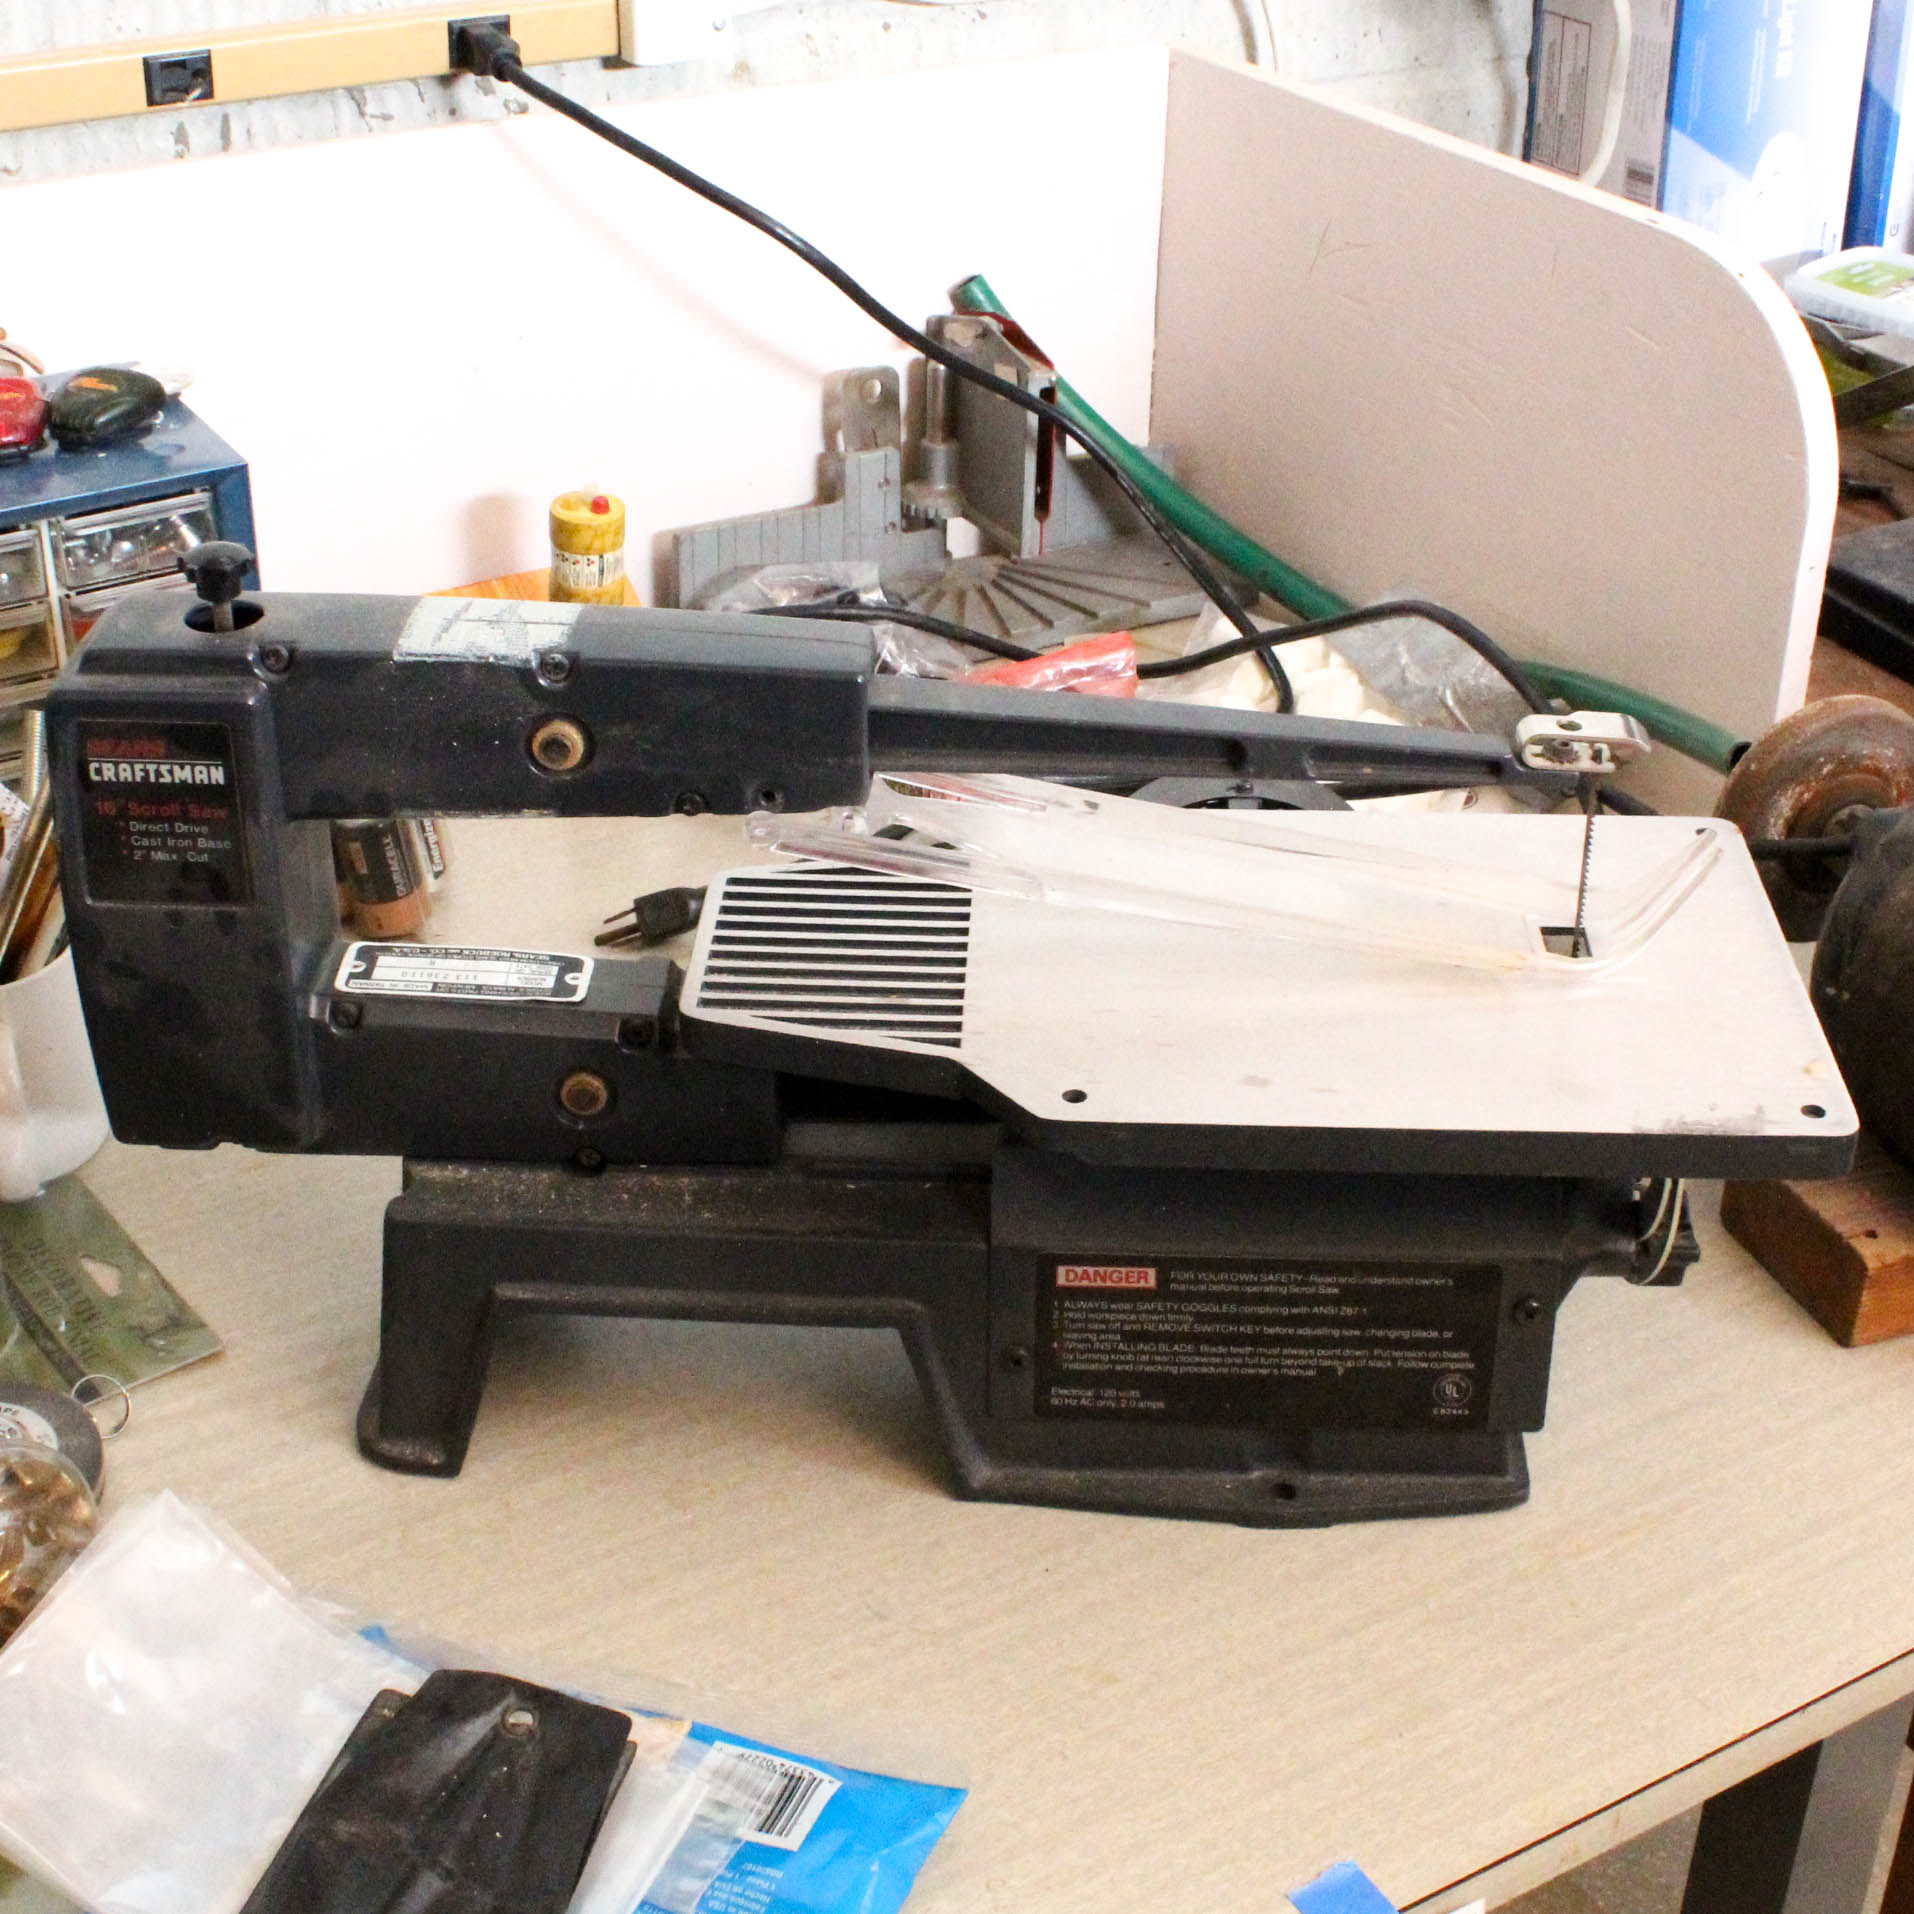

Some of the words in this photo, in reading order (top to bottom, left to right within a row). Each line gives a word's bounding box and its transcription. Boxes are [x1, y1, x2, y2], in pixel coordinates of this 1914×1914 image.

[89, 761, 225, 785] CRAFTSMAN
[129, 821, 169, 833] Direct
[174, 822, 209, 834] Drive
[131, 836, 162, 847] Cast
[168, 837, 193, 848] Iron
[198, 838, 232, 850] Base
[187, 852, 209, 863] Cut
[383, 833, 407, 896] DURACELL
[1064, 1268, 1150, 1284] DANGER
[1170, 1272, 1194, 1282] FOR
[1196, 1272, 1229, 1282] YOUR
[1231, 1273, 1259, 1283] OWN
[1260, 1274, 1302, 1284] SAFETY
[1170, 1282, 1206, 1292] manual
[1208, 1283, 1240, 1293] before
[1242, 1284, 1288, 1296] operating
[1289, 1285, 1318, 1295] Scroll
[1064, 1300, 1109, 1310] ALWAYS
[1110, 1303, 1134, 1311] wear
[1136, 1302, 1180, 1312] SAFETY
[1181, 1303, 1237, 1313] GOGGLES
[1239, 1304, 1289, 1316] complying
[1291, 1305, 1310, 1315] with
[1312, 1305, 1338, 1316] ANSI
[1064, 1312, 1086, 1321] Hold
[1086, 1312, 1138, 1324] workpiece
[1139, 1313, 1164, 1322] down
[1065, 1321, 1086, 1330] Turn
[1109, 1321, 1122, 1331] off
[1123, 1322, 1143, 1331] and
[1144, 1322, 1191, 1332] REMOVE
[1194, 1323, 1238, 1333] SWITCH
[1239, 1324, 1261, 1334] KEY
[1263, 1325, 1295, 1335] before
[1296, 1326, 1340, 1338] adjusting
[1365, 1327, 1410, 1339] changing
[1065, 1342, 1092, 1351] When
[1093, 1343, 1156, 1352] INSTALLING
[1200, 1345, 1228, 1354] Blade
[1230, 1345, 1255, 1355] teeth
[1257, 1346, 1280, 1355] must
[1281, 1347, 1315, 1358] always
[1316, 1347, 1341, 1358] point
[1391, 1349, 1426, 1358] tension
[1063, 1352, 1075, 1363] by
[1076, 1352, 1109, 1364] turning
[1110, 1353, 1135, 1362] knob
[1175, 1354, 1222, 1364] clockwise
[1260, 1356, 1280, 1365] turn
[1281, 1356, 1318, 1368] beyond
[1397, 1359, 1428, 1368] Follow
[1430, 1359, 1475, 1371] complete
[1063, 1362, 1113, 1372] installation
[1114, 1363, 1133, 1373] and
[1134, 1364, 1178, 1376] checking
[1179, 1365, 1229, 1377] procedure
[1241, 1366, 1279, 1376] owner's
[1065, 1397, 1078, 1407] Hz
[1080, 1398, 1096, 1407] AC
